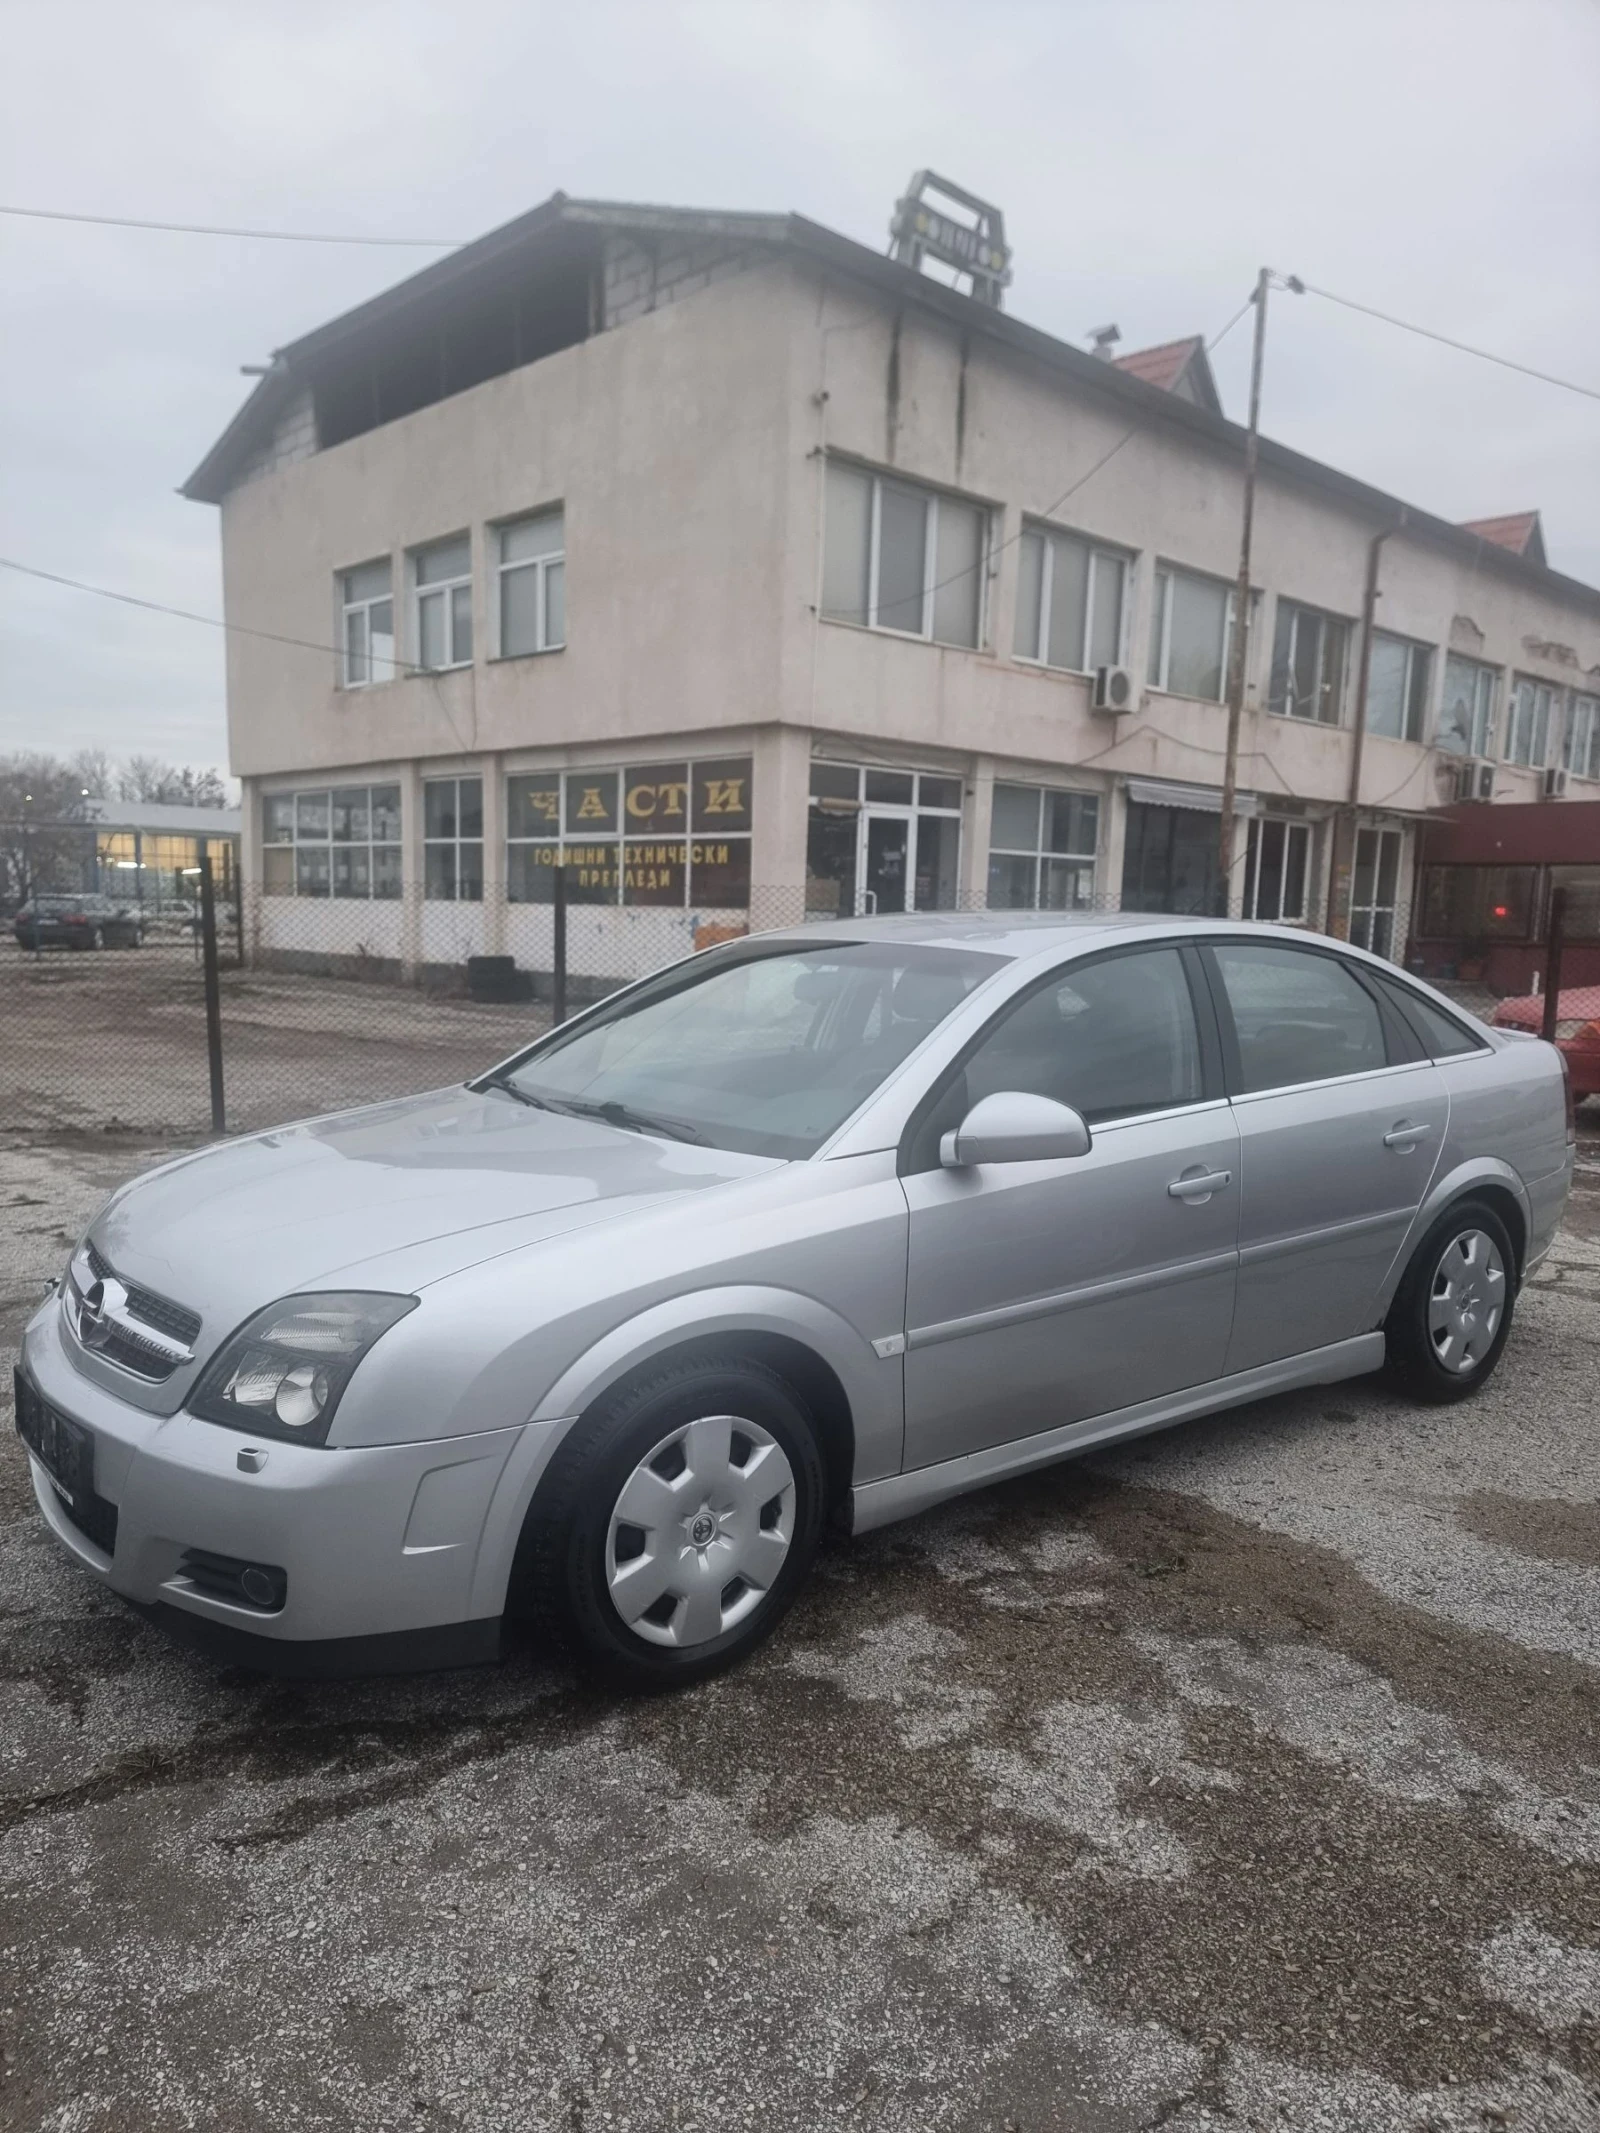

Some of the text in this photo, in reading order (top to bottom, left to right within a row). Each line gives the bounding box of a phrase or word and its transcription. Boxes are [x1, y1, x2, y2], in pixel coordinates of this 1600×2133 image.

[529, 779, 744, 819] ЧАСТИ
[534, 845, 728, 866] ГОДИШНИ ТЕХНИЧЕСКИ
[580, 869, 670, 888] ПРЕГЛЕДИ
